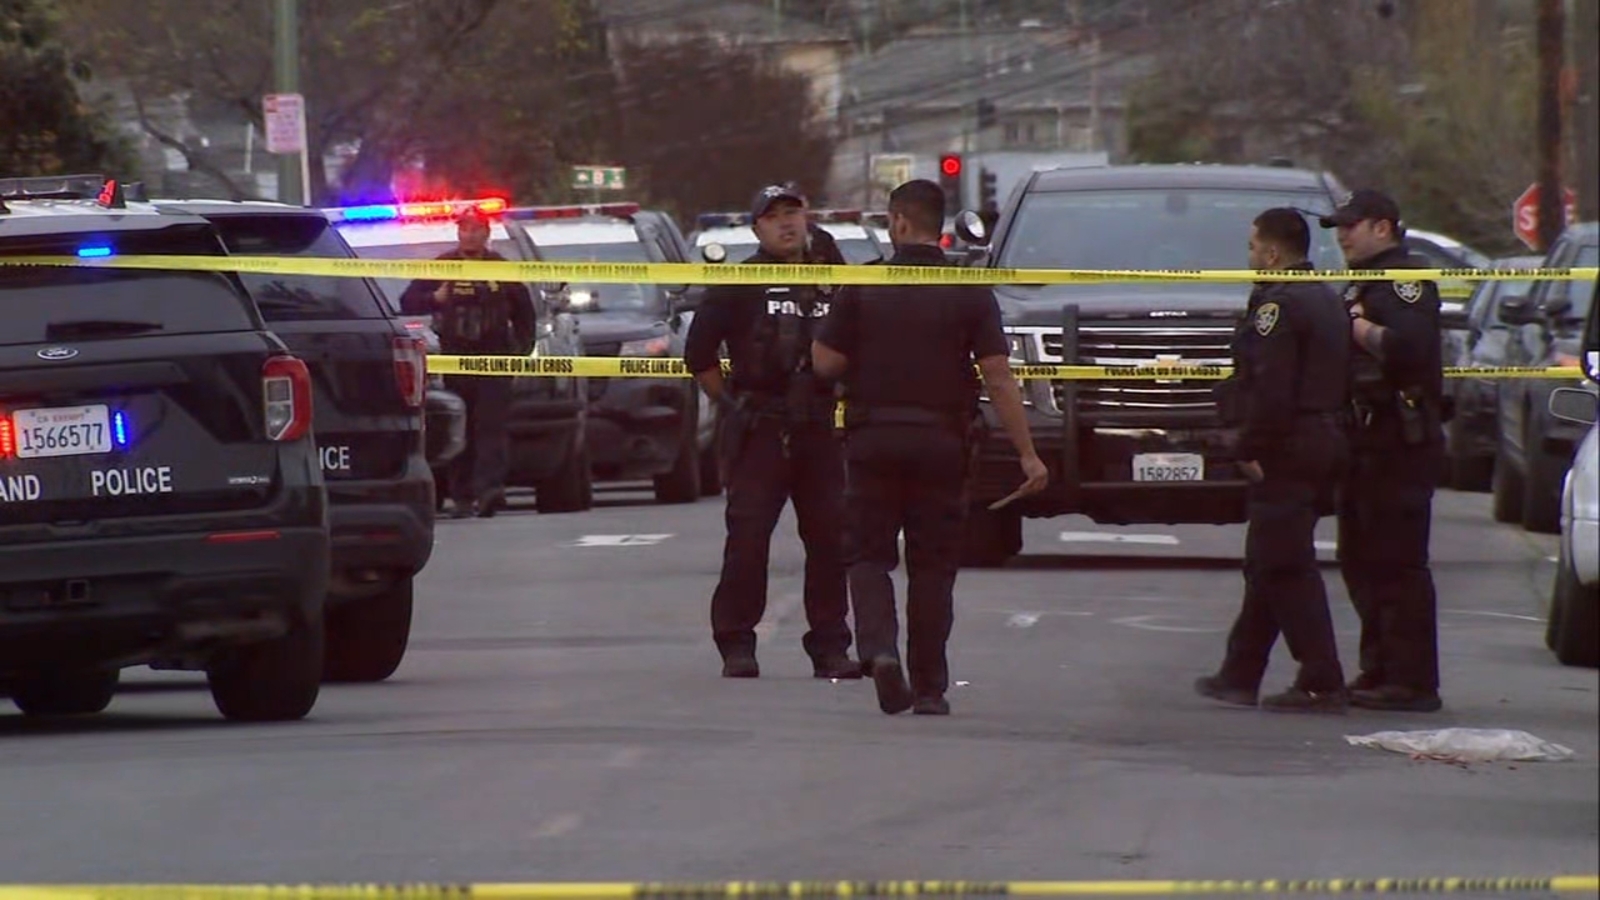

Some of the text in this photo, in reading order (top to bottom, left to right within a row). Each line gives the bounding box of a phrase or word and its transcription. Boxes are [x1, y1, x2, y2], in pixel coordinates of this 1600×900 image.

[459, 357, 573, 373] POLICE LINE DO NOT CROSS
[620, 359, 684, 374] POLICE LINE DO
[22, 423, 103, 450] 1566577
[91, 466, 173, 496] POLICE
